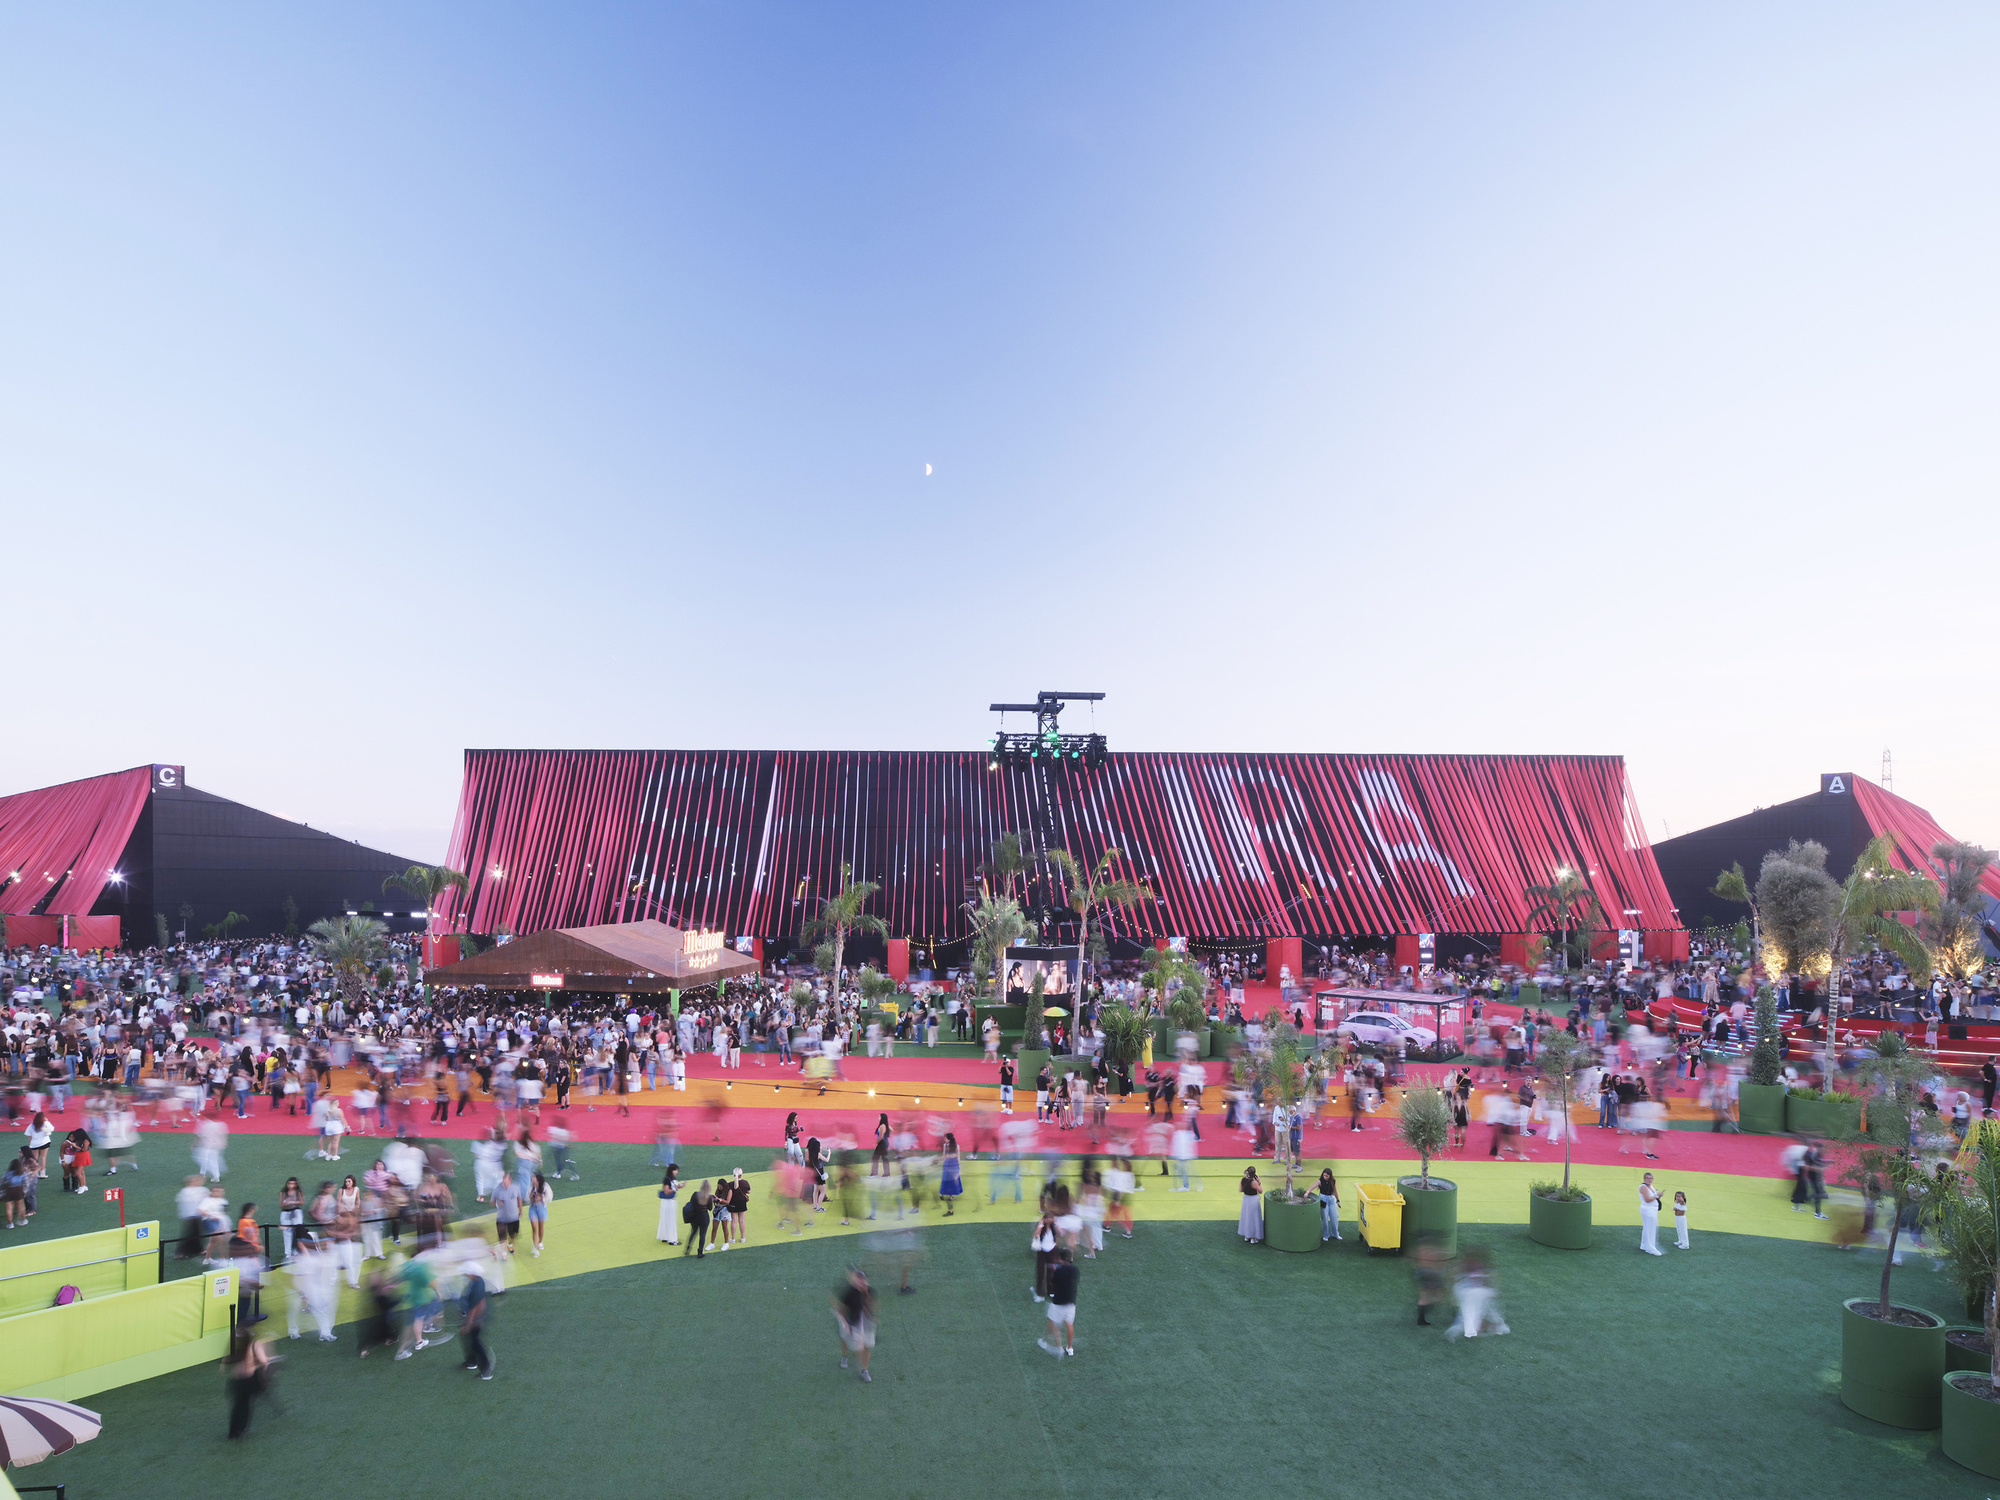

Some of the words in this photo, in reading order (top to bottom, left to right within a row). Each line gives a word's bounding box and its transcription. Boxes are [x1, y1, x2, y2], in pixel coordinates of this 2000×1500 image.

[159, 768, 176, 783] C
[1829, 776, 1845, 791] A
[628, 762, 1475, 901] SHAKIRA
[684, 927, 724, 954] Mahou
[533, 975, 562, 985] Mahou
